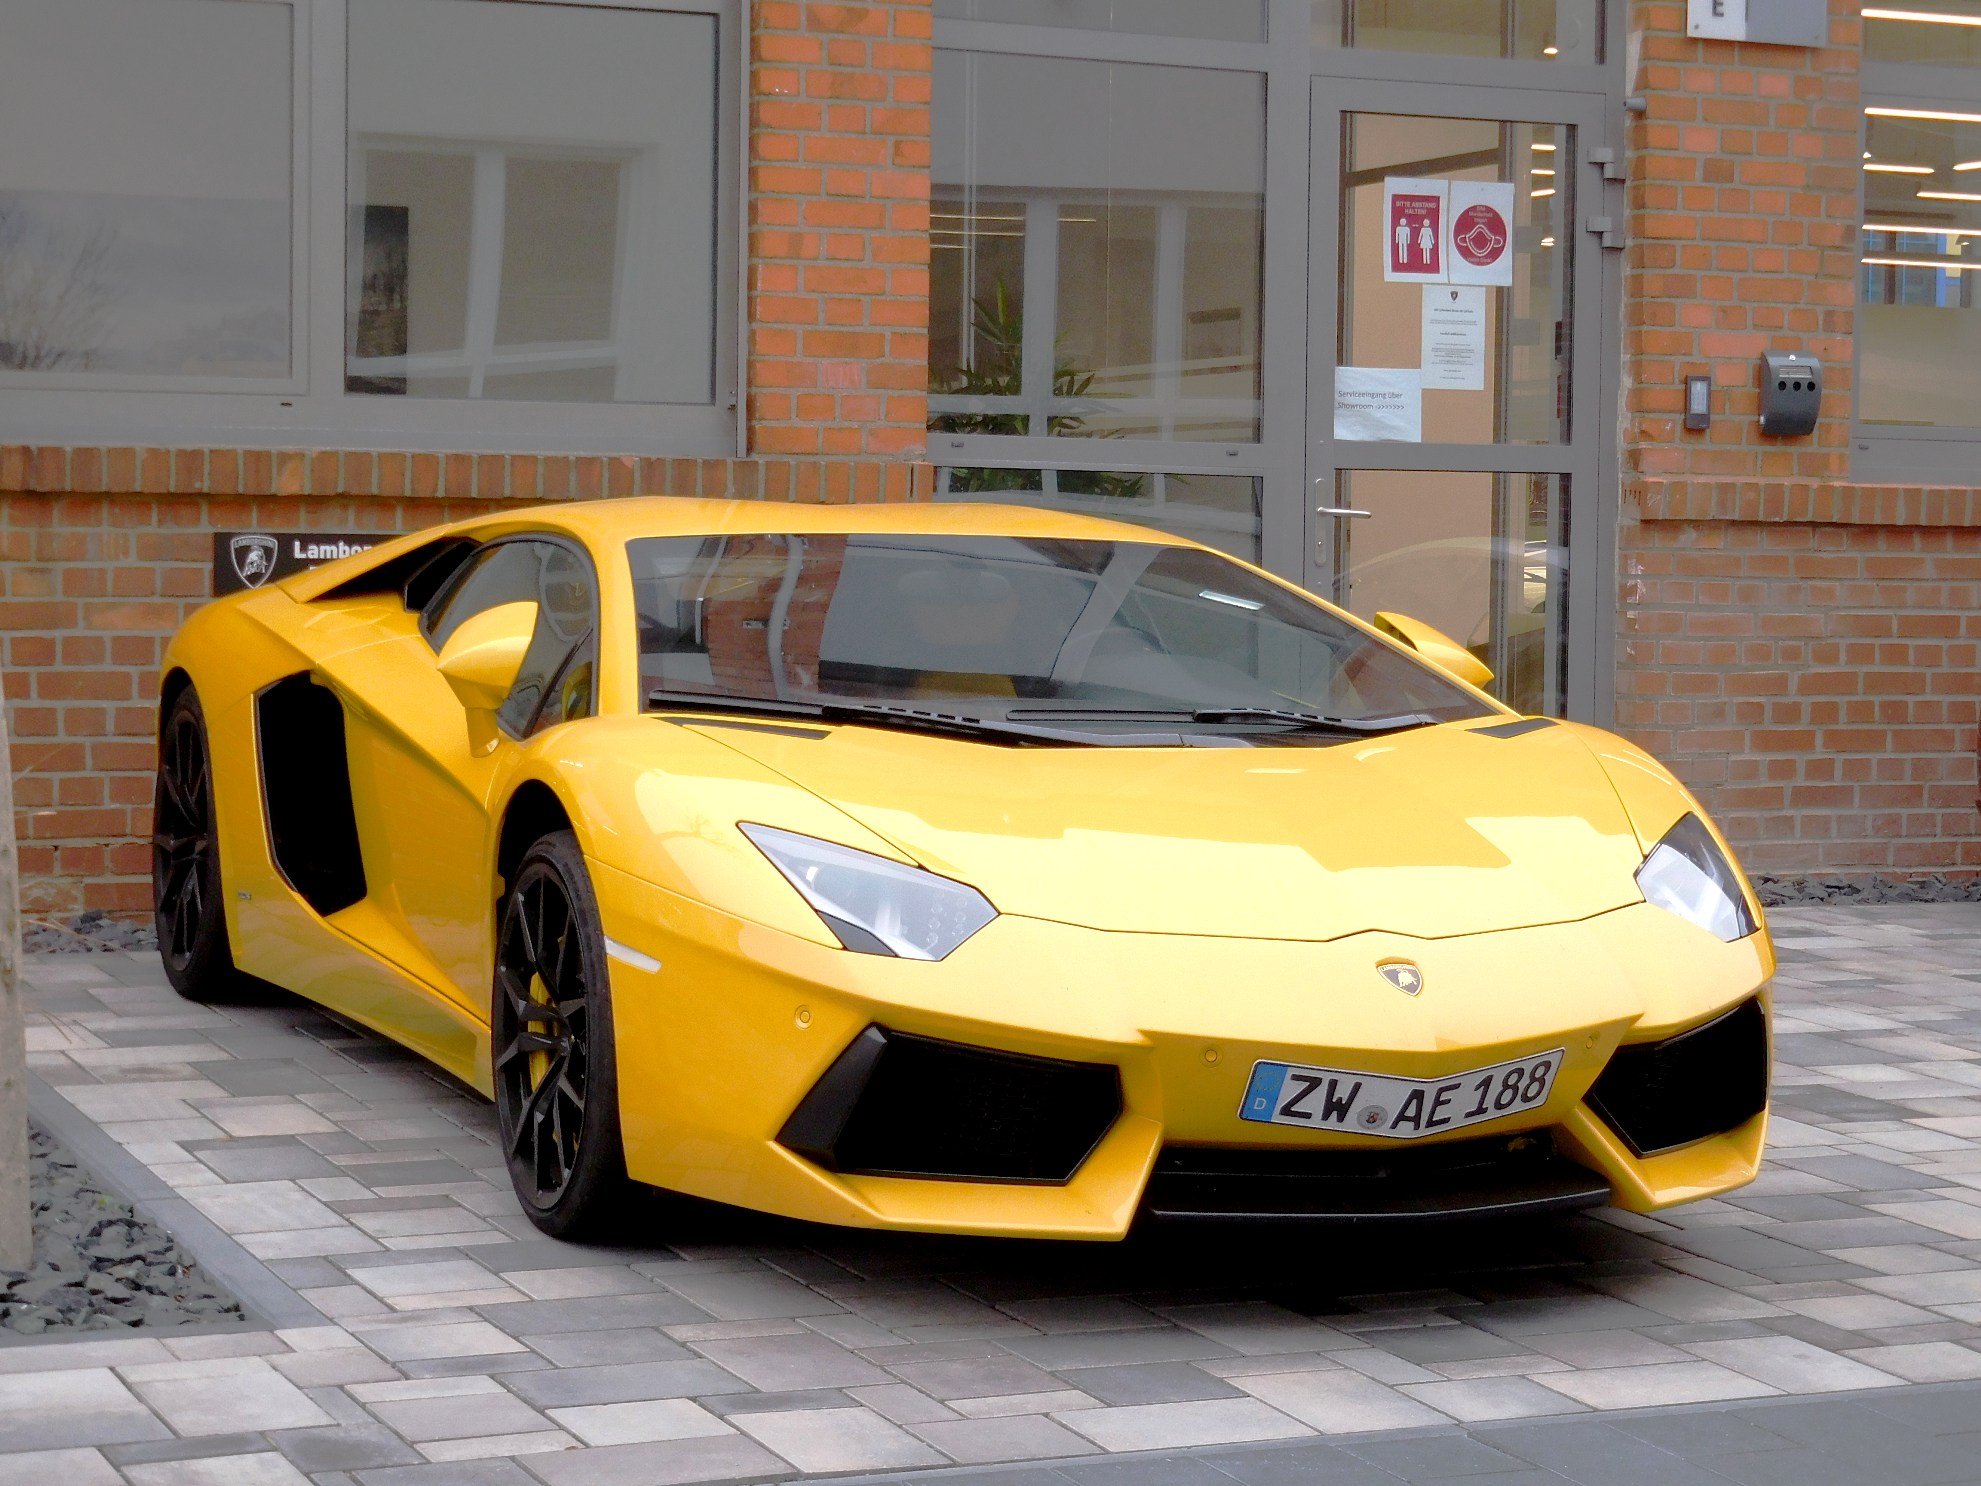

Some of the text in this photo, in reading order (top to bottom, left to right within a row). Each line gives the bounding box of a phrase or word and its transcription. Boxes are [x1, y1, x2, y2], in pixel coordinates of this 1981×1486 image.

[1337, 391, 1403, 400] Serviceeingang über
[1337, 402, 1374, 410] Showroom
[1279, 1060, 1552, 1131] ZW AE 188
[1254, 1097, 1267, 1110] D
